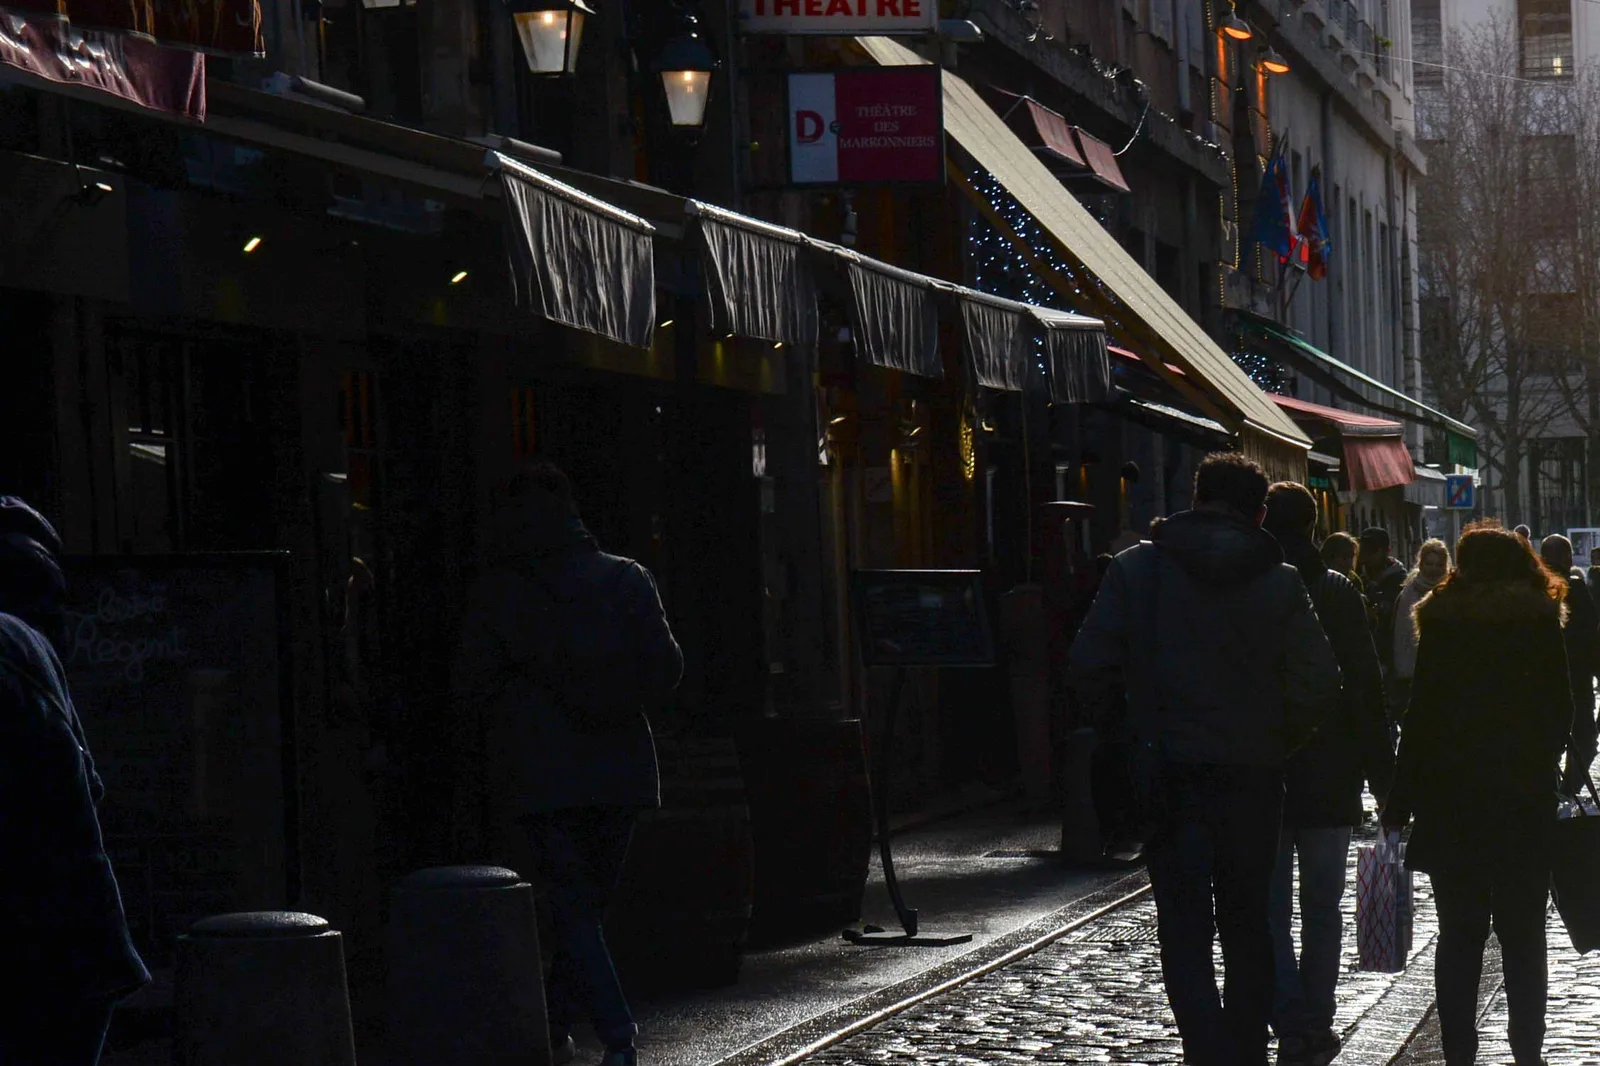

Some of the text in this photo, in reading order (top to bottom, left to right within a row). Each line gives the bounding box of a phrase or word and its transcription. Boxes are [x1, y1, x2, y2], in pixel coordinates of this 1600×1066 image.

[855, 102, 917, 118] THÉÂTRE
[874, 120, 900, 133] DES
[839, 135, 936, 149] MARRONNIERS
